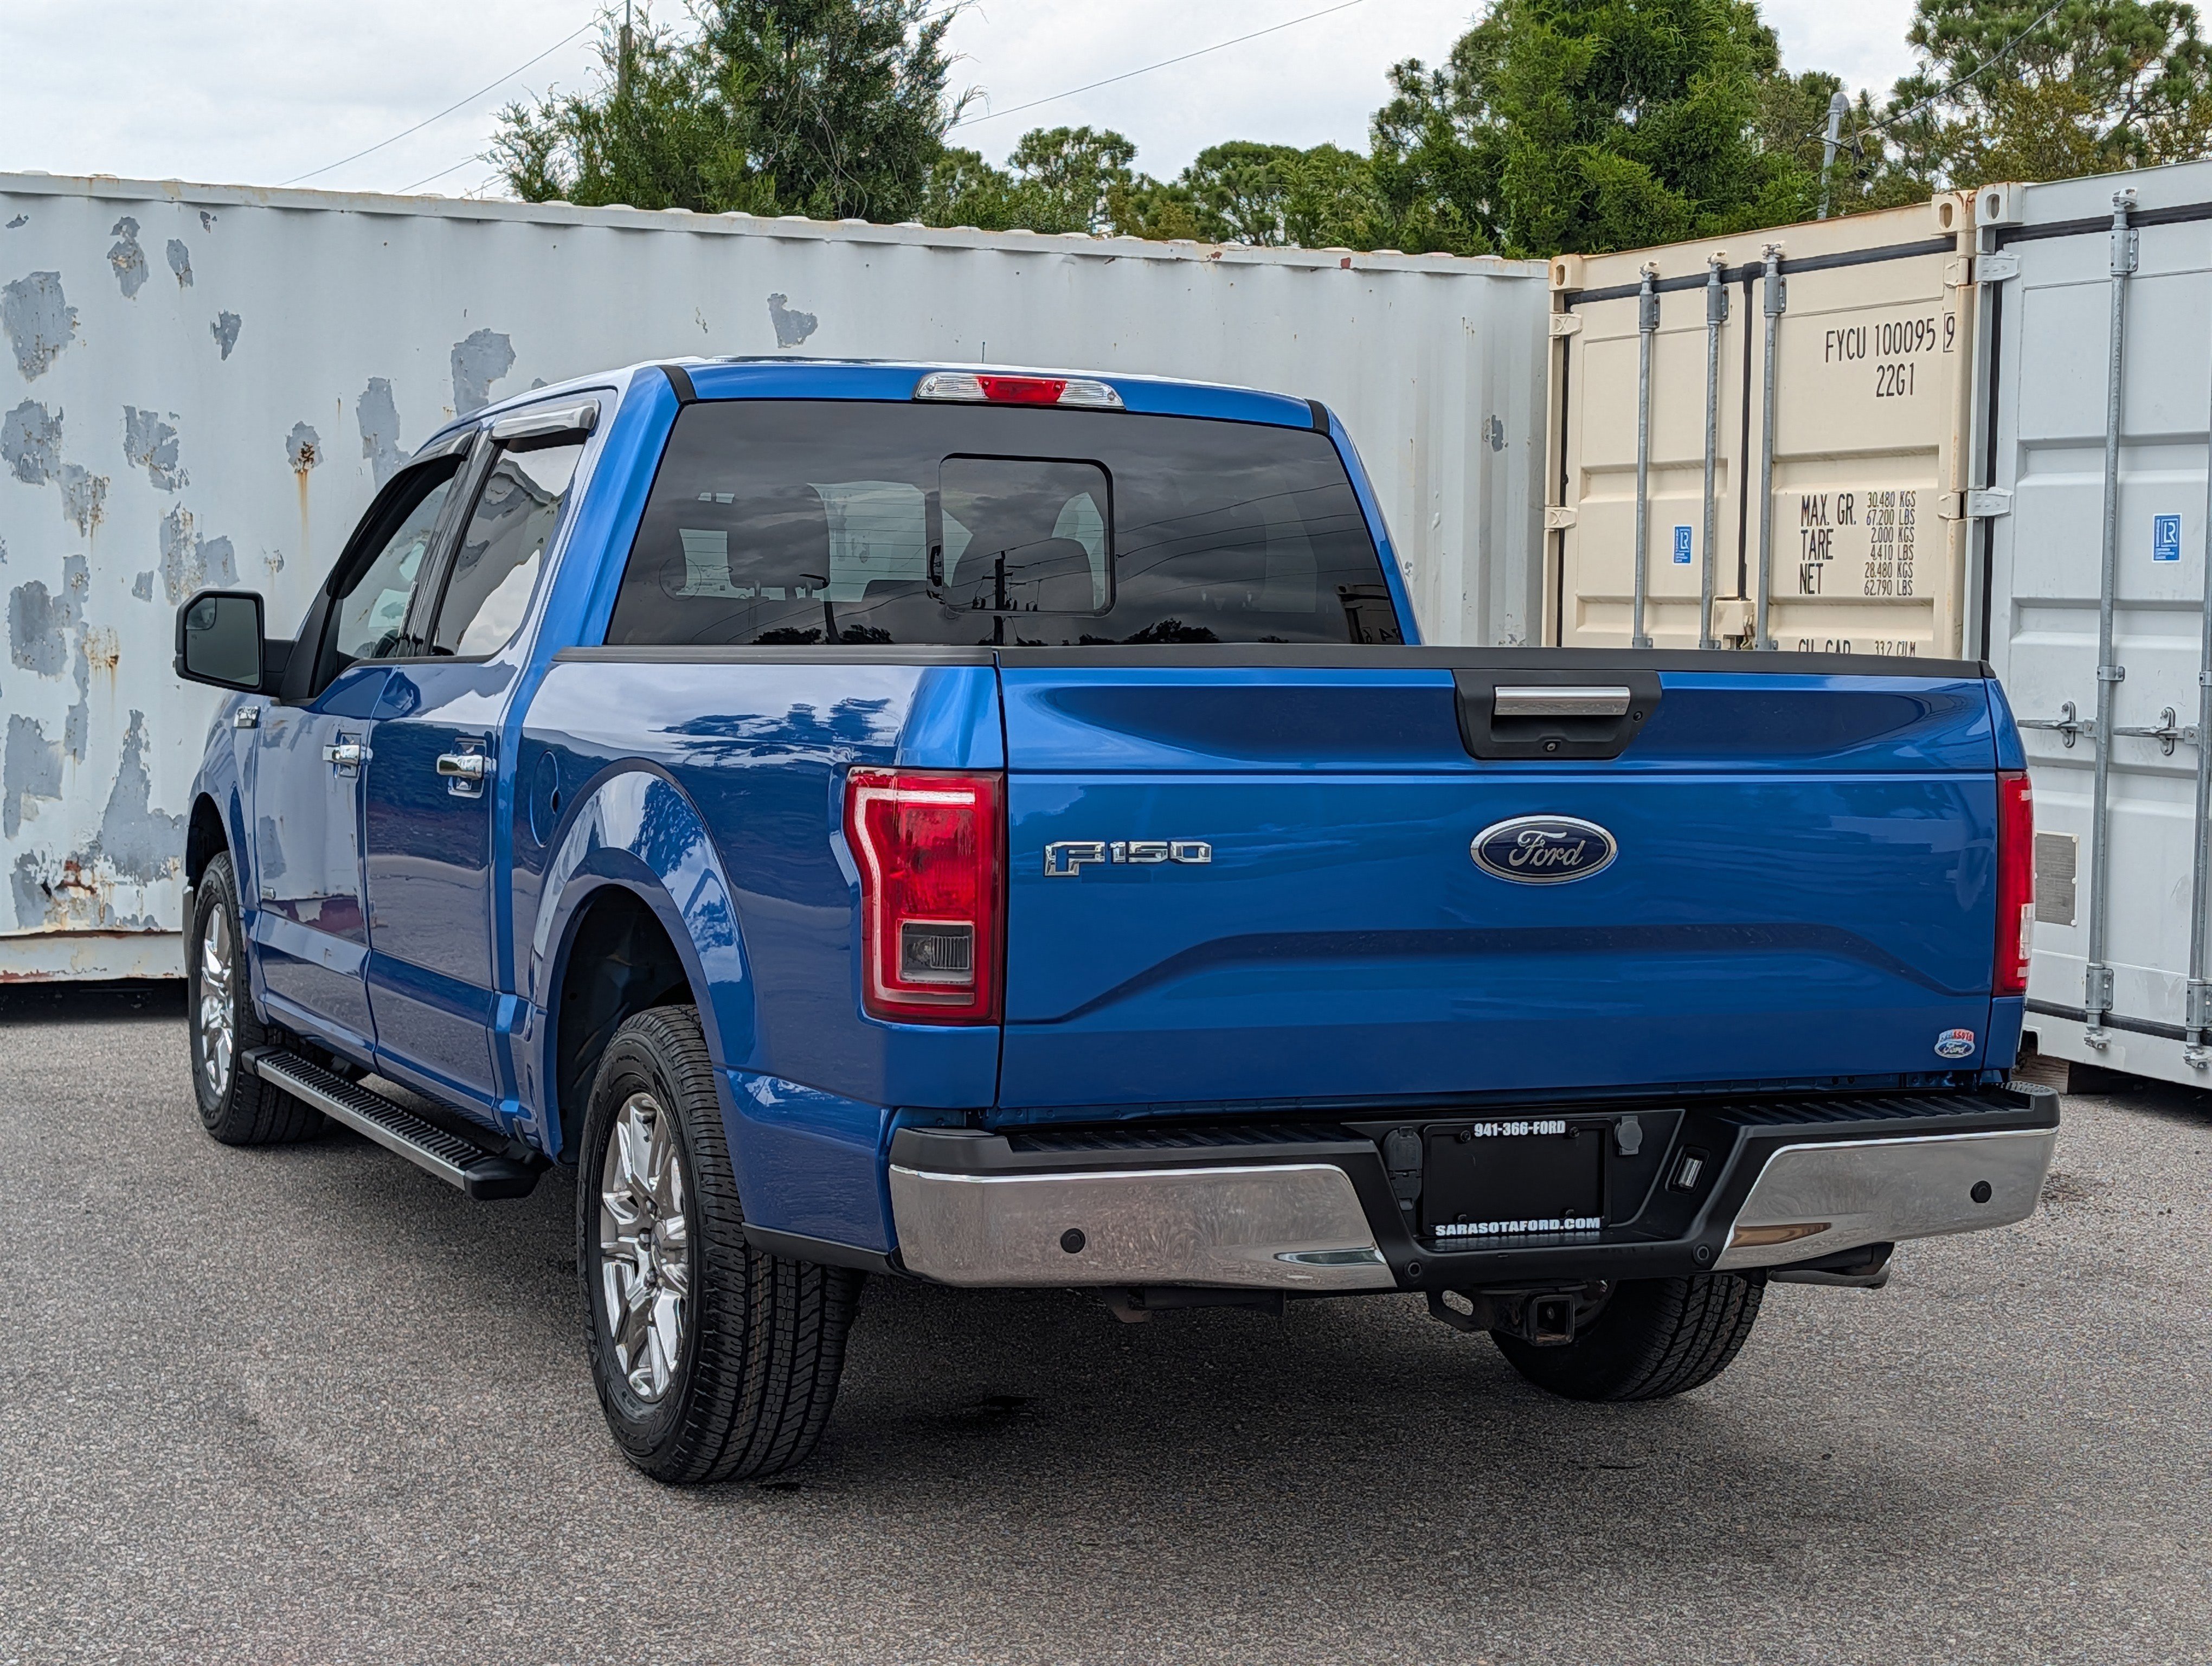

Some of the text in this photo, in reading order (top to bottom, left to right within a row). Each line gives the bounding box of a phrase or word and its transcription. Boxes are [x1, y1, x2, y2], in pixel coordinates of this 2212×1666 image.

[1825, 315, 1955, 363] FYCU 100095 9
[1876, 362, 1914, 398] 22G1
[1837, 493, 1856, 526] GR.
[1867, 491, 1895, 508] 30.480
[1899, 490, 1916, 508] KGS
[1866, 508, 1915, 526] 67.200 LBS
[1801, 528, 1834, 561] TARE
[1898, 526, 1915, 543] KGS
[1898, 544, 1914, 561] LBS
[1799, 561, 1913, 594] NET 28.480 KGS
[1896, 579, 1913, 596] LBS
[1509, 830, 1586, 866] Ford
[1474, 1120, 1566, 1137] 941-366-FORD
[1435, 1217, 1600, 1236] SARASOTAFORD.COM
